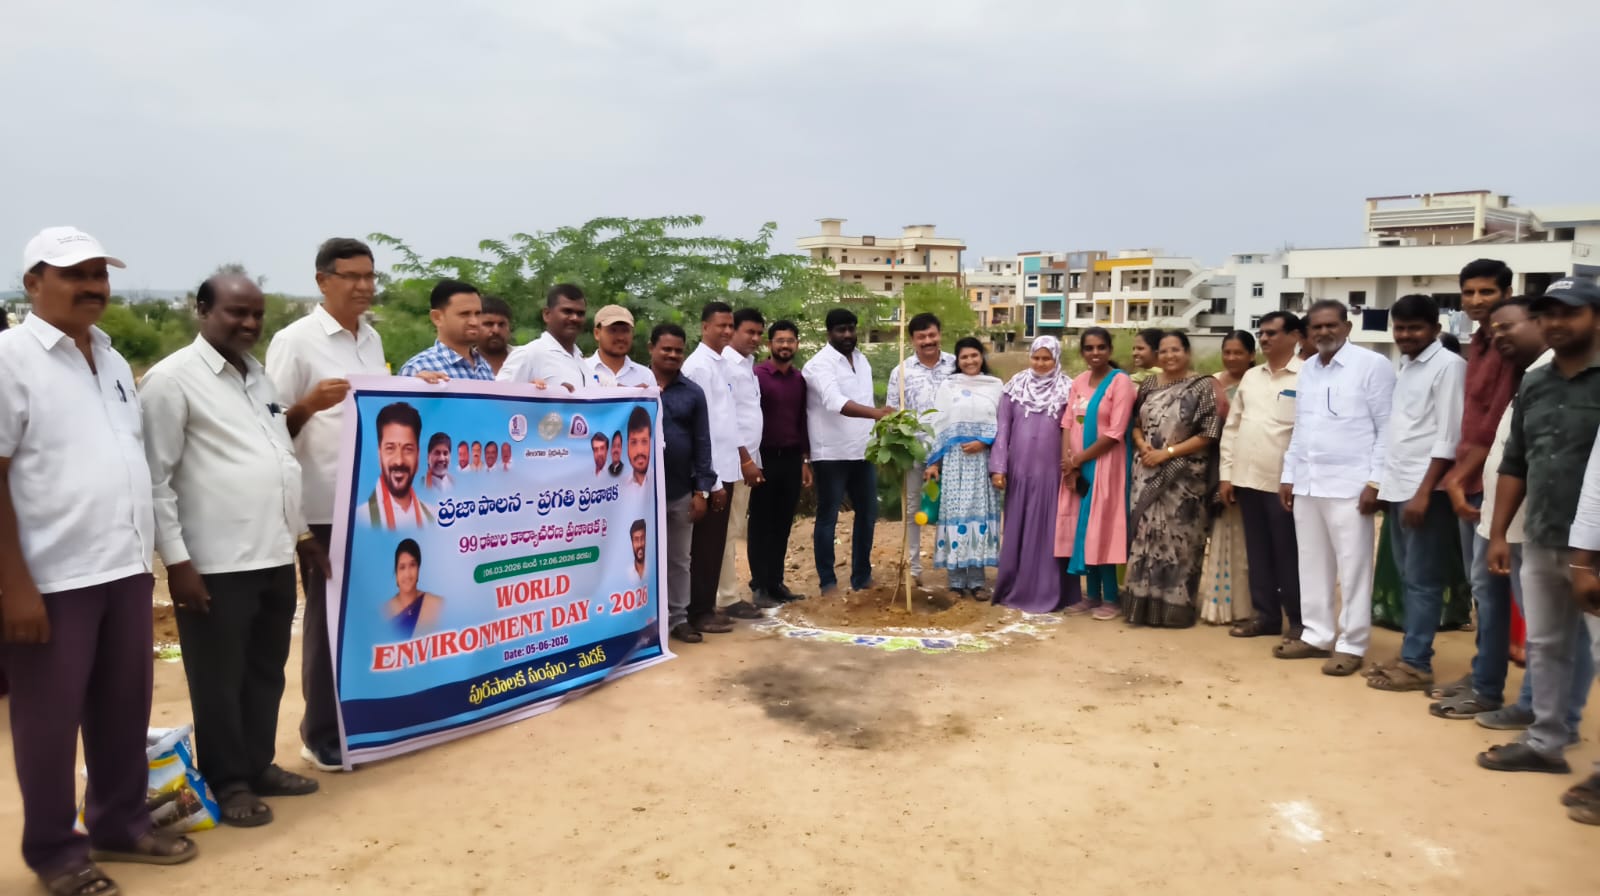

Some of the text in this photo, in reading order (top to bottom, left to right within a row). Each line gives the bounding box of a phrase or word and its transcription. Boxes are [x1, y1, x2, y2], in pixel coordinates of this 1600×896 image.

[437, 498, 476, 527] ప్రజా
[478, 492, 522, 516] పాలన
[537, 488, 576, 516] ప్రగతి
[578, 484, 619, 512] ప్రణాళిక
[459, 535, 478, 553] 99
[479, 532, 508, 550] రోజుల
[495, 574, 570, 608] WORLD
[371, 610, 545, 670] ENVIRONMENT
[551, 600, 590, 628] DAY
[610, 585, 648, 613] 2026
[504, 634, 569, 661] Date: 05-06-2026
[469, 670, 527, 704] పురపాలక
[528, 661, 567, 684] సంఘం
[577, 644, 607, 669] మెదక్
